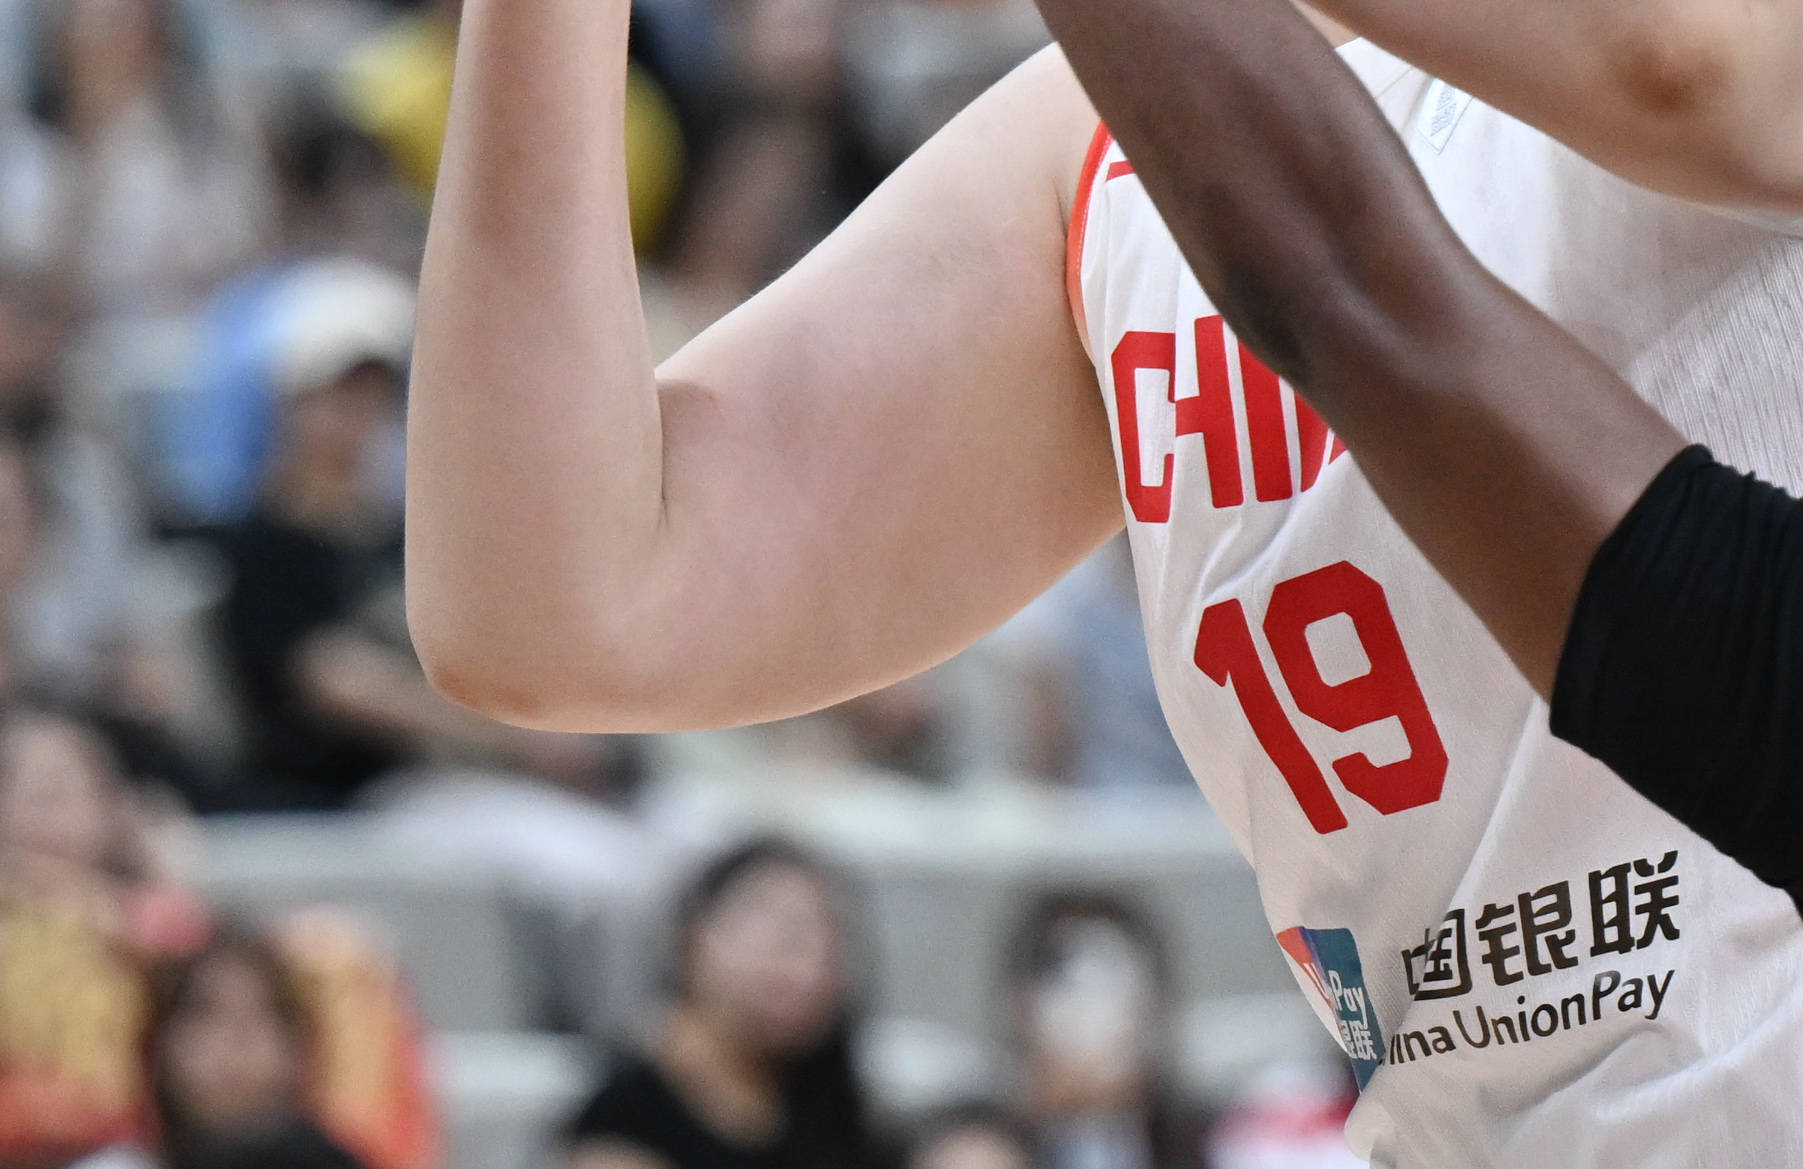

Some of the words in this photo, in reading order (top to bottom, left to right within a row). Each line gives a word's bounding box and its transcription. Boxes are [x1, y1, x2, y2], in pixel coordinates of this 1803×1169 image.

[1110, 313, 1349, 524] CHI
[1194, 560, 1449, 835] 19
[1452, 968, 1676, 1049] UnionPay
